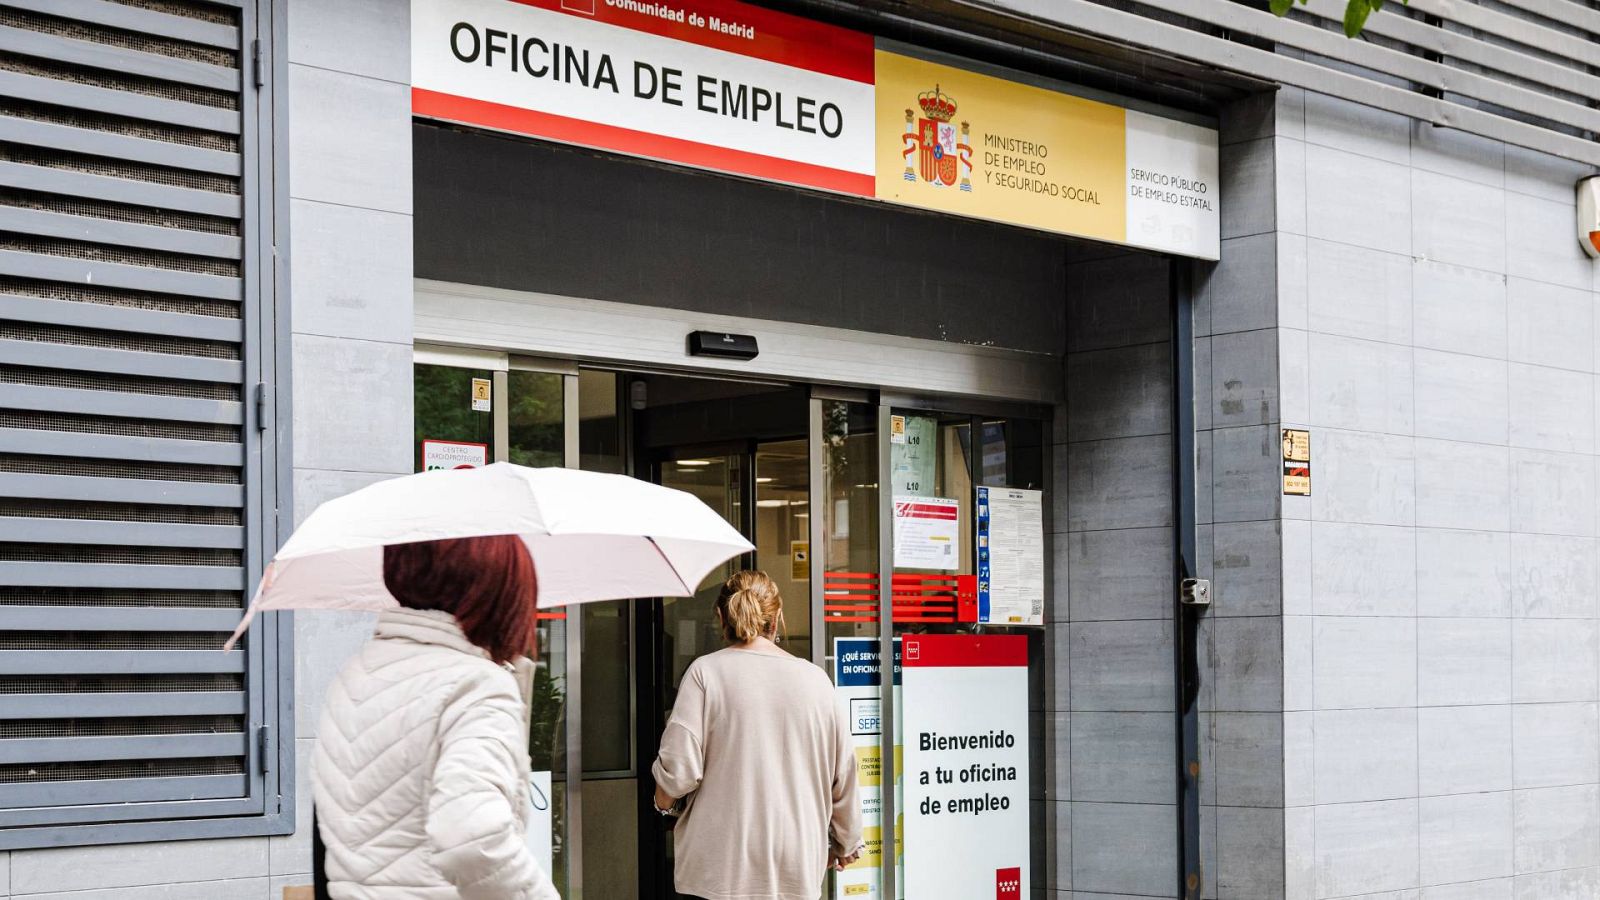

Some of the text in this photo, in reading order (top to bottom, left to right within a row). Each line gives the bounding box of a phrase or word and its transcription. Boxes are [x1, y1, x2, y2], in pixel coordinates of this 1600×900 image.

[688, 12, 705, 28] de
[709, 16, 754, 40] Madrid
[449, 21, 844, 139] OFICINA DE EMPLEO
[984, 132, 1048, 159] MINISTERIO
[984, 152, 1046, 176] DE EMPLEO
[984, 170, 1100, 206] Y SEGURIDAD SOCIAL
[1131, 168, 1207, 194] SERVICIO PÚBLICO
[1131, 185, 1213, 212] DE EMPLEO ESTATAL
[442, 446, 469, 454] CENTRO
[908, 436, 920, 445] L10
[906, 482, 919, 491] L10
[842, 650, 859, 663] ¿QUÉ
[843, 666, 852, 674] EN
[858, 718, 881, 730] SEPE
[919, 730, 1015, 752] Bienvenido
[919, 763, 1017, 785] a tu oficina
[919, 793, 1010, 816] de empleo
